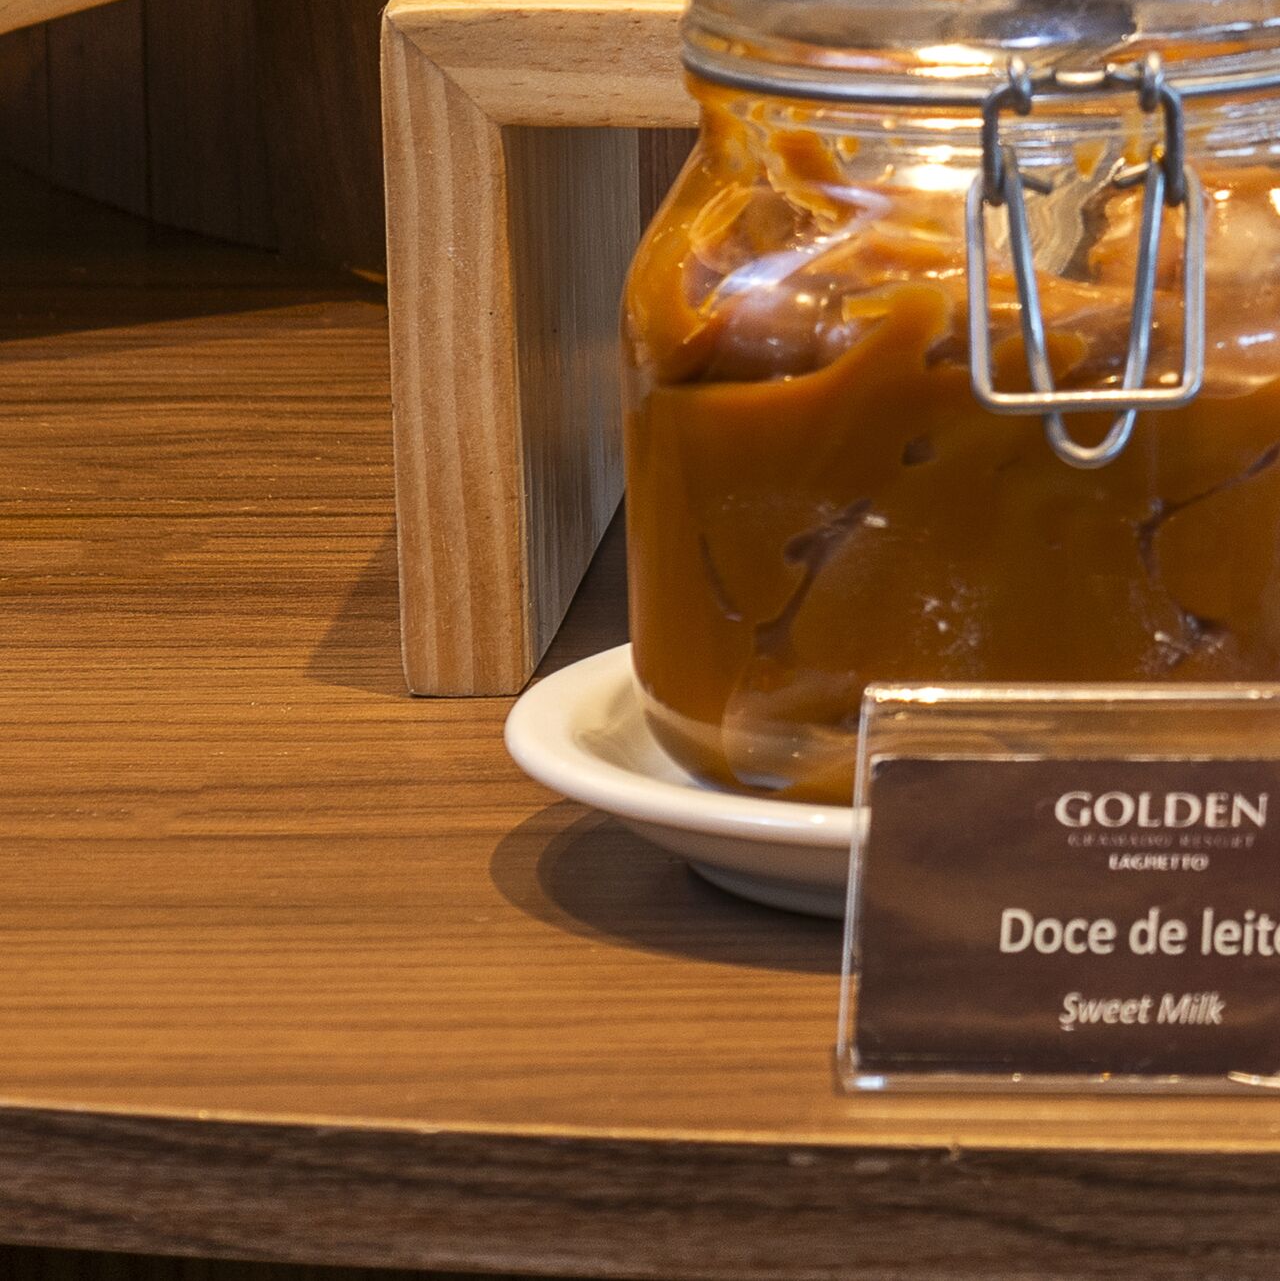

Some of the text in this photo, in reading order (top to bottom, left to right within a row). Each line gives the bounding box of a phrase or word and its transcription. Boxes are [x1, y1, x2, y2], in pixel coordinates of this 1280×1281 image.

[1054, 790, 1269, 829] GOLDEN
[999, 906, 1117, 955] Doce
[1128, 906, 1188, 955] de
[1058, 991, 1226, 1026] Sweet Milk
